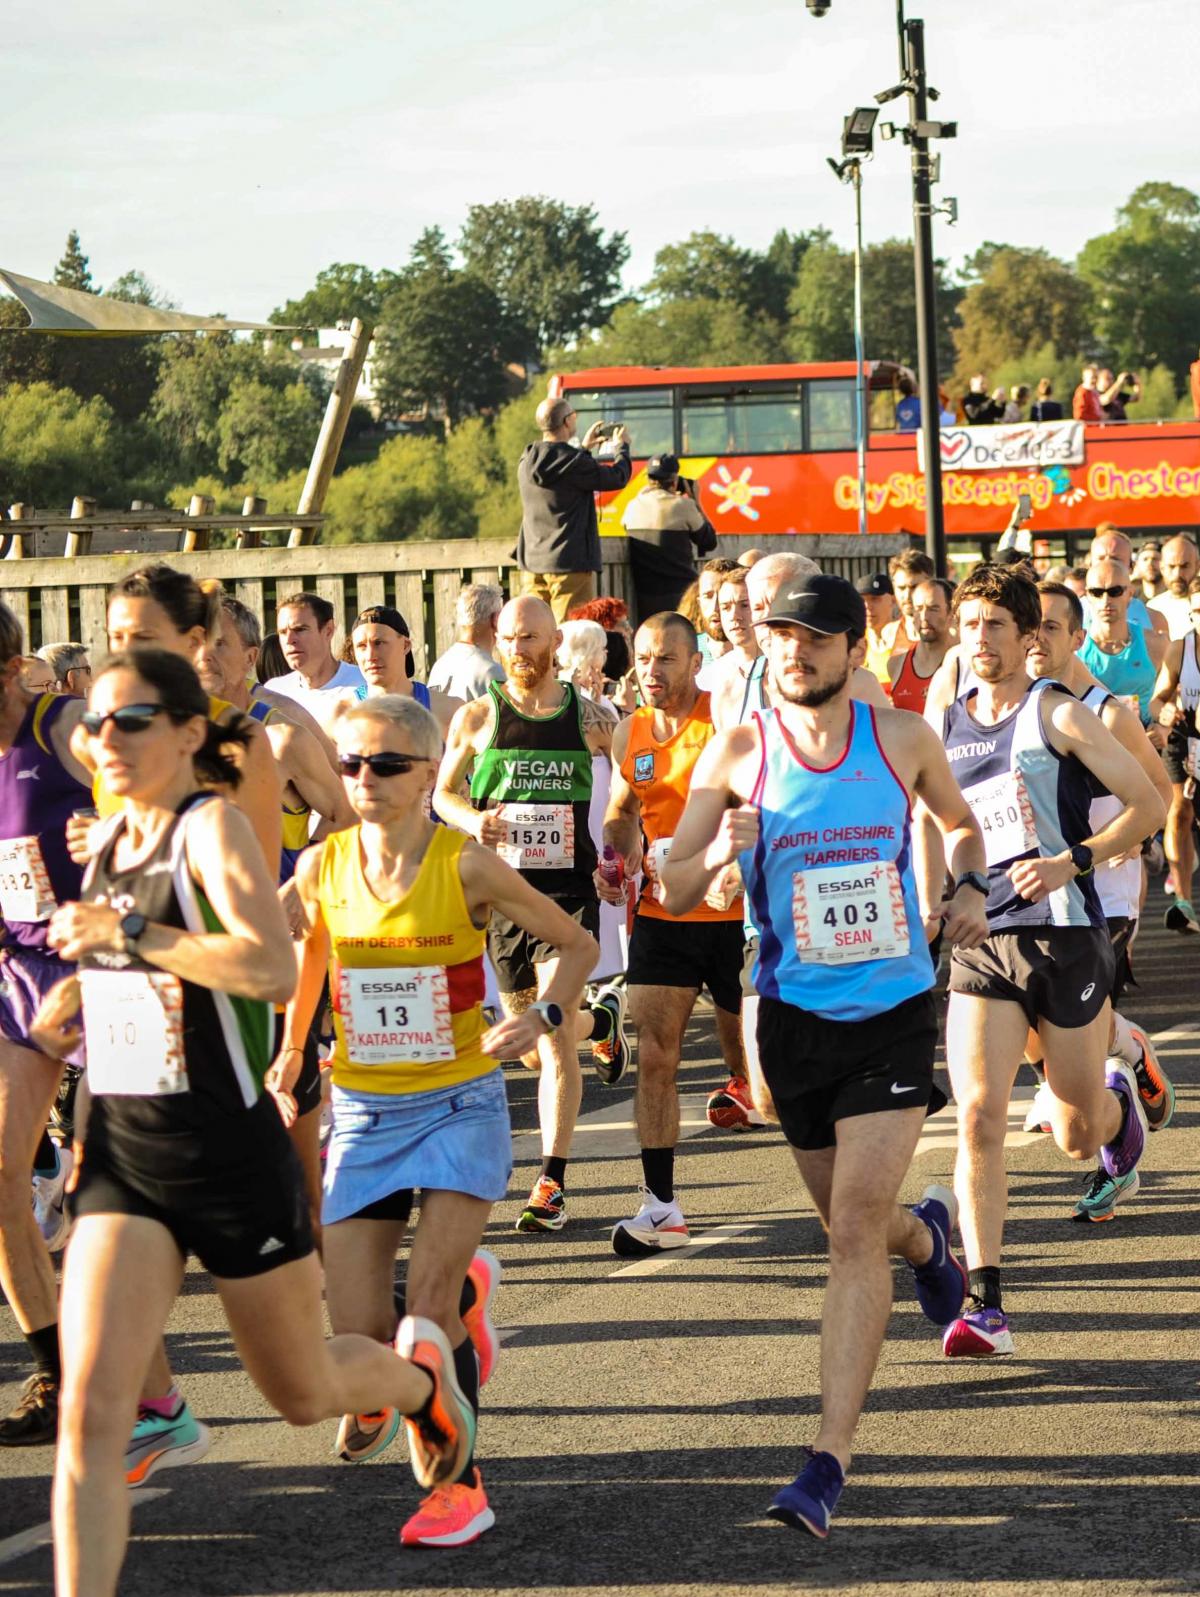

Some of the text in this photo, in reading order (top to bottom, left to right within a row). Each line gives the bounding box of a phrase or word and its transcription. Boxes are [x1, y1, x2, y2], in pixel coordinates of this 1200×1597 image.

[504, 761, 574, 777] VEGAN
[503, 779, 572, 790] RUNNERS
[983, 806, 1018, 832] 450
[511, 830, 560, 845] 1520
[771, 826, 896, 851] SOUTH CHESHIRE
[525, 848, 546, 857] DAN
[804, 848, 880, 866] HARRIERS
[818, 877, 876, 894] ESSAR
[823, 902, 879, 928] 403
[369, 934, 455, 948] DERBYSHIRE
[834, 929, 873, 947] SEAN
[361, 982, 417, 993] ESSAR
[376, 1006, 409, 1027] 13
[358, 1032, 434, 1046] KATARZYNA
